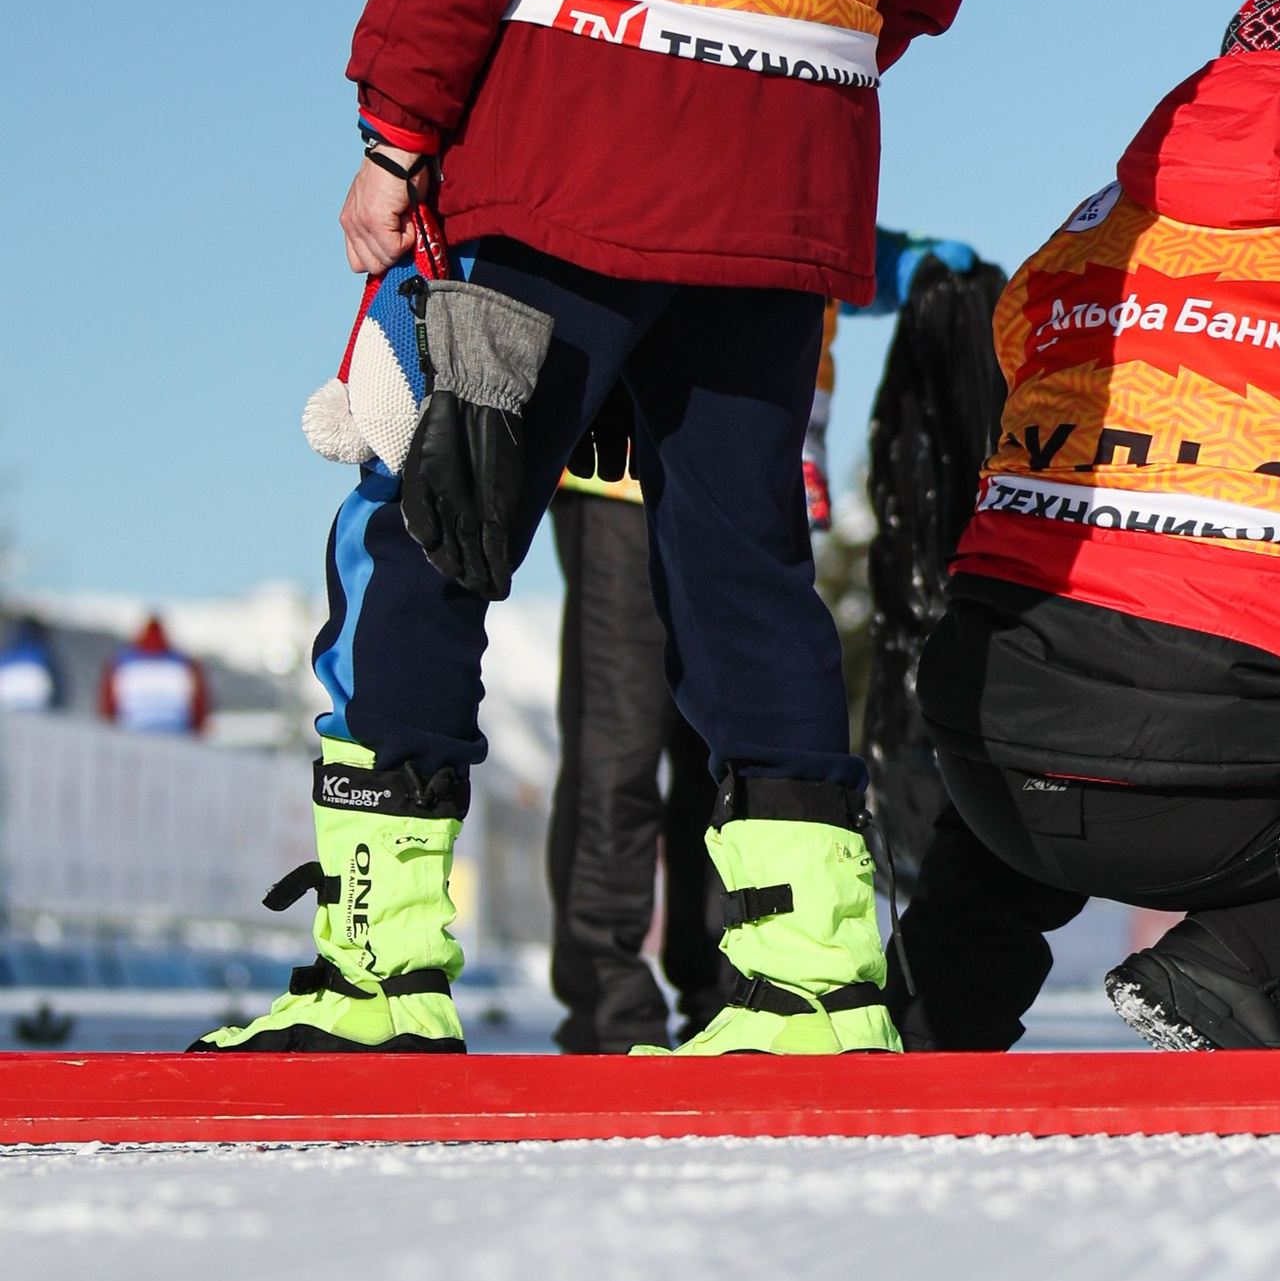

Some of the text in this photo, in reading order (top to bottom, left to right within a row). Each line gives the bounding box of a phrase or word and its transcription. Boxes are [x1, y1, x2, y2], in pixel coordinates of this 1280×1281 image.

[1035, 293, 1168, 353] Альфа
[322, 775, 349, 798] KC
[346, 875, 355, 924] AUTHENTIC
[353, 842, 371, 939] ONE
